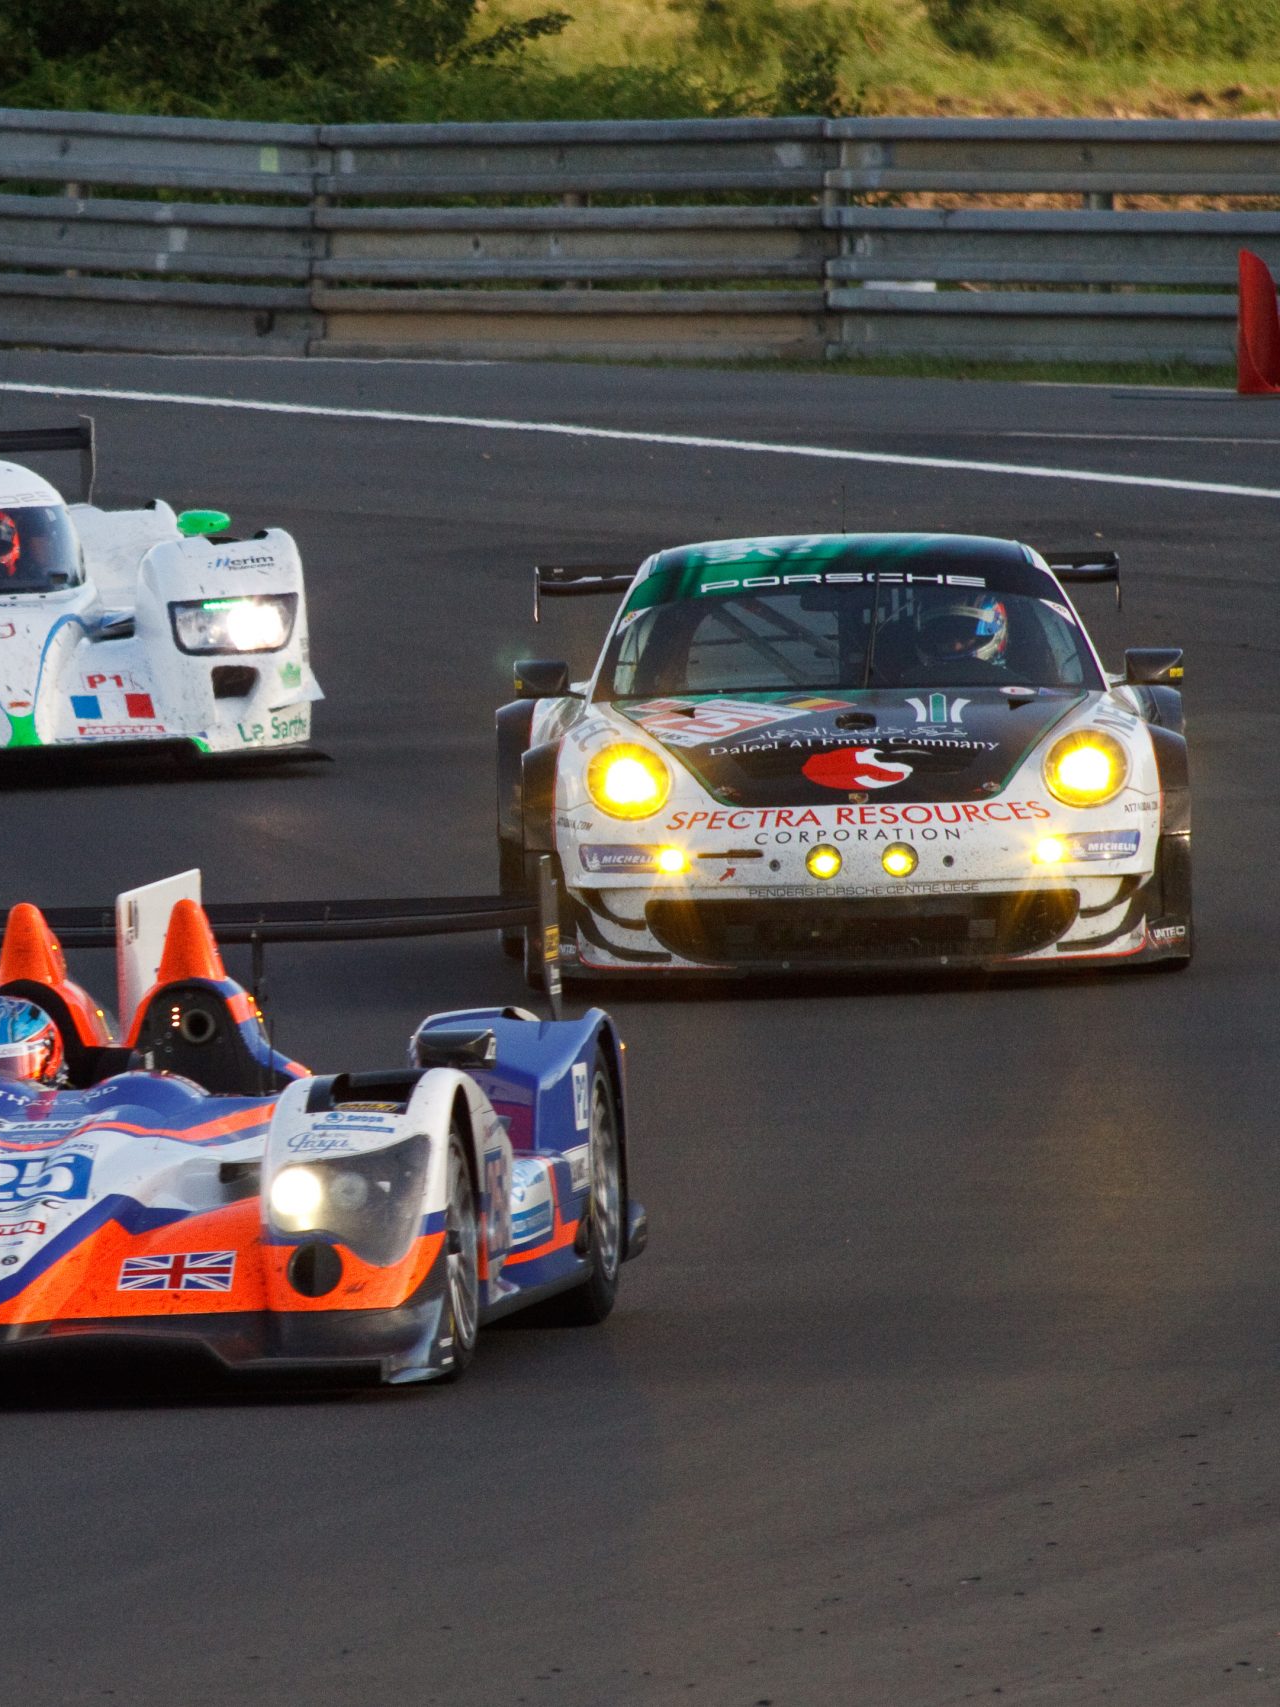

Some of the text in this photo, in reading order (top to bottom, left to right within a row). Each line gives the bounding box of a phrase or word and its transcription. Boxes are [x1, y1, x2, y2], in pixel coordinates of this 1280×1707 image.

[701, 572, 986, 593] PORSCHE
[86, 673, 124, 689] P1
[665, 800, 1051, 831] SPECTRA RESOURCES
[754, 828, 961, 846] CORPORATION
[1088, 842, 1137, 852] MICHELIN
[816, 886, 883, 897] PORSCHE
[886, 884, 941, 896] CENTRE
